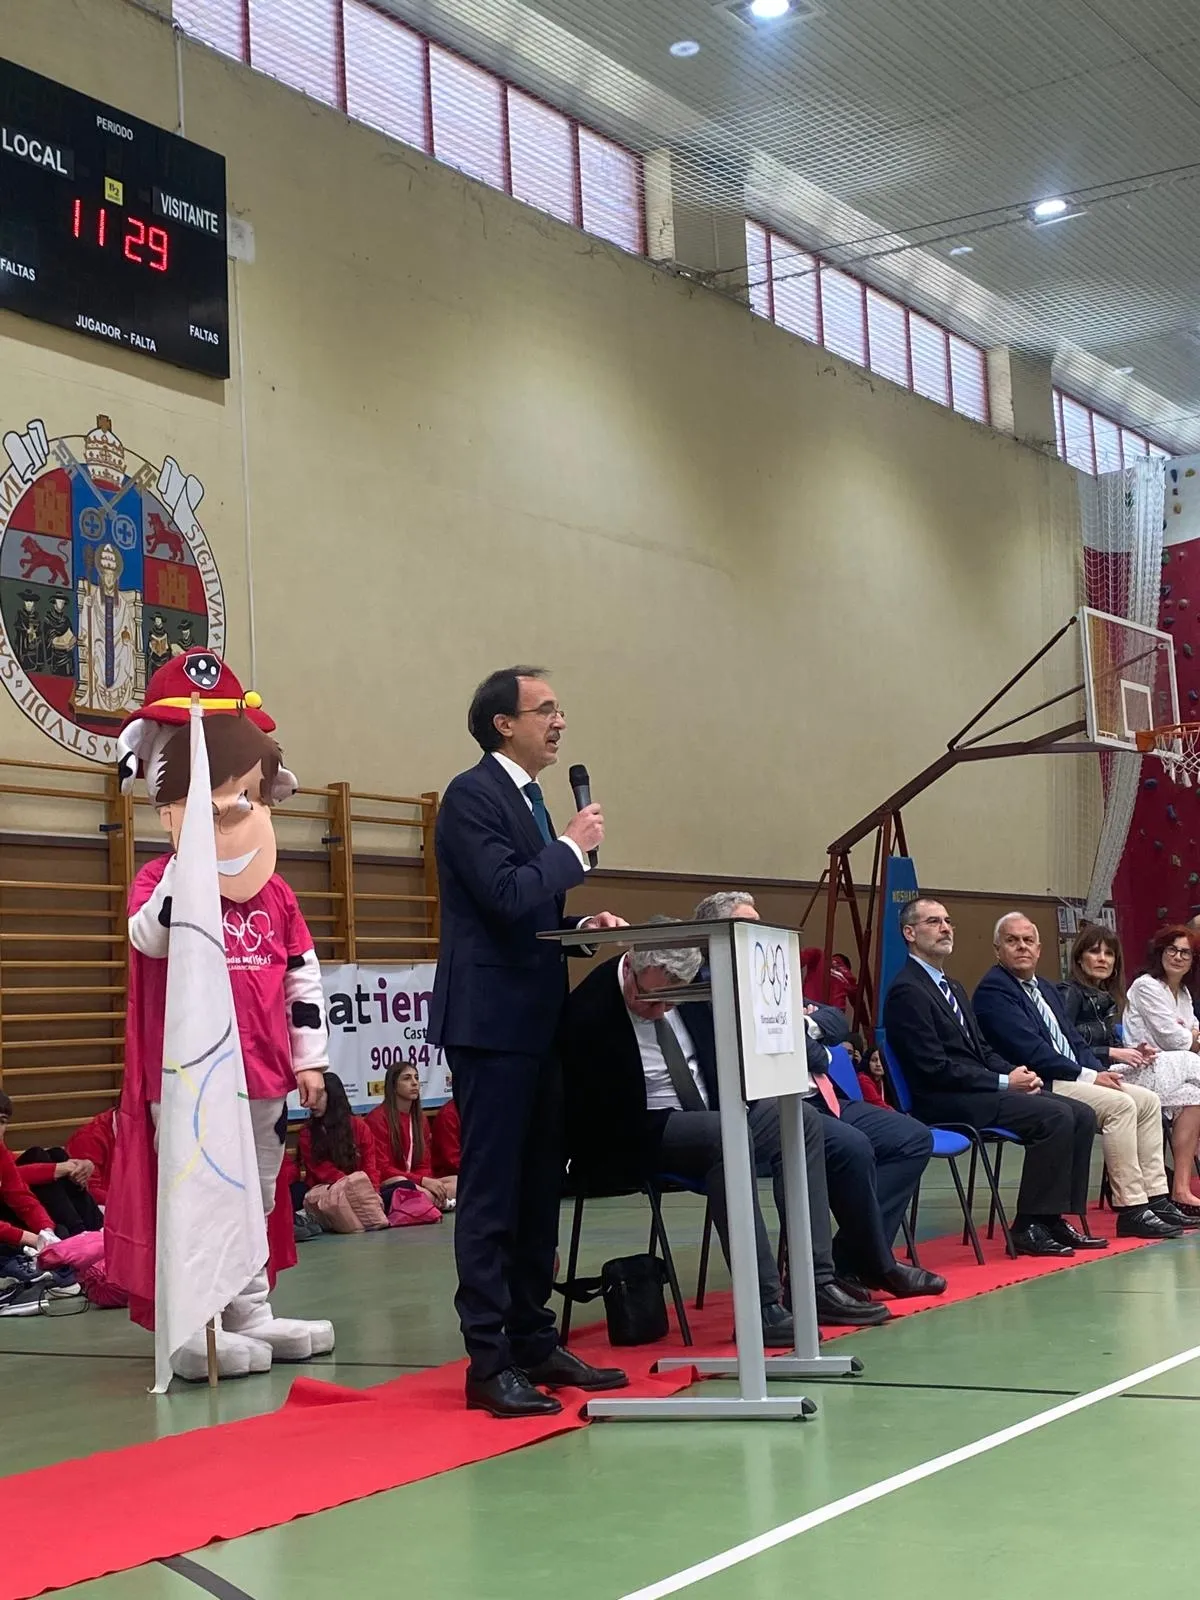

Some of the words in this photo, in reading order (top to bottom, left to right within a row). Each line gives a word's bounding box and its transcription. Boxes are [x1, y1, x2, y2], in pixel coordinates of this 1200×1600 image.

[96, 115, 134, 141] PERIODO
[2, 127, 68, 175] LOCAL
[160, 192, 219, 234] VISITANTE
[124, 216, 168, 271] 29
[0, 257, 36, 282] FALTAS
[75, 314, 121, 340] JUGADOR
[130, 331, 157, 352] FALTA
[189, 323, 220, 346] FALTAS
[370, 1046, 403, 1071] 900
[408, 1044, 431, 1068] 84
